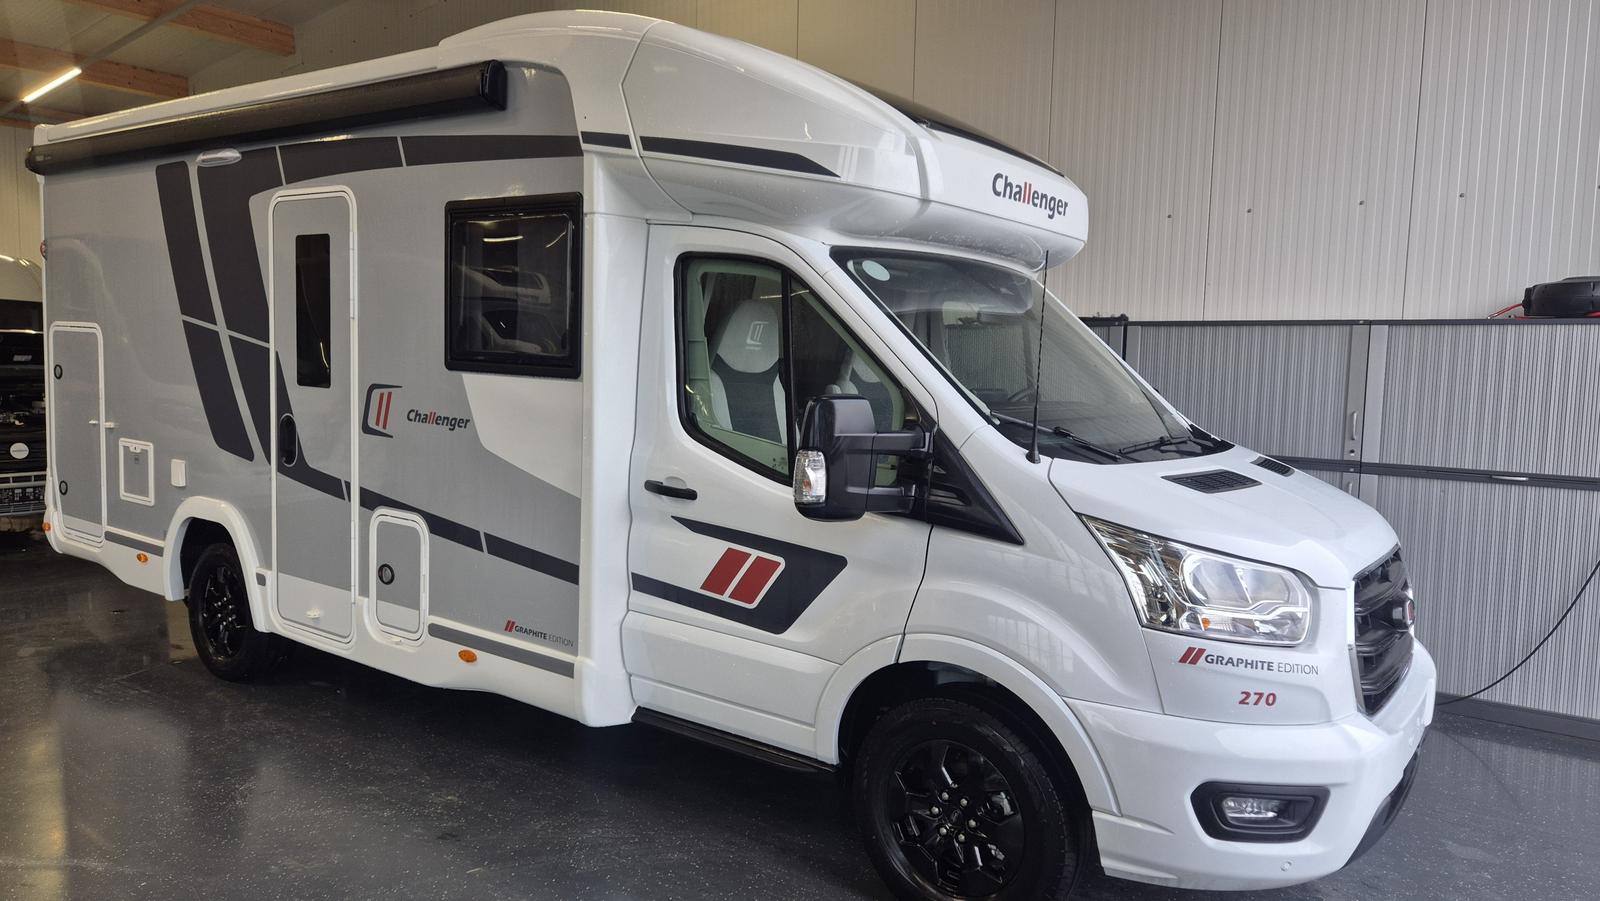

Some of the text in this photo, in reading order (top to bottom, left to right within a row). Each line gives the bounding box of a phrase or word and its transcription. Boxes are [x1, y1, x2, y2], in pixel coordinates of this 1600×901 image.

[992, 173, 1068, 219] Challenger
[407, 409, 470, 431] Challenger
[514, 625, 574, 647] GRAPHITE EDITION
[1204, 653, 1319, 675] GRAPHITE EDITION
[1238, 691, 1277, 707] 270
